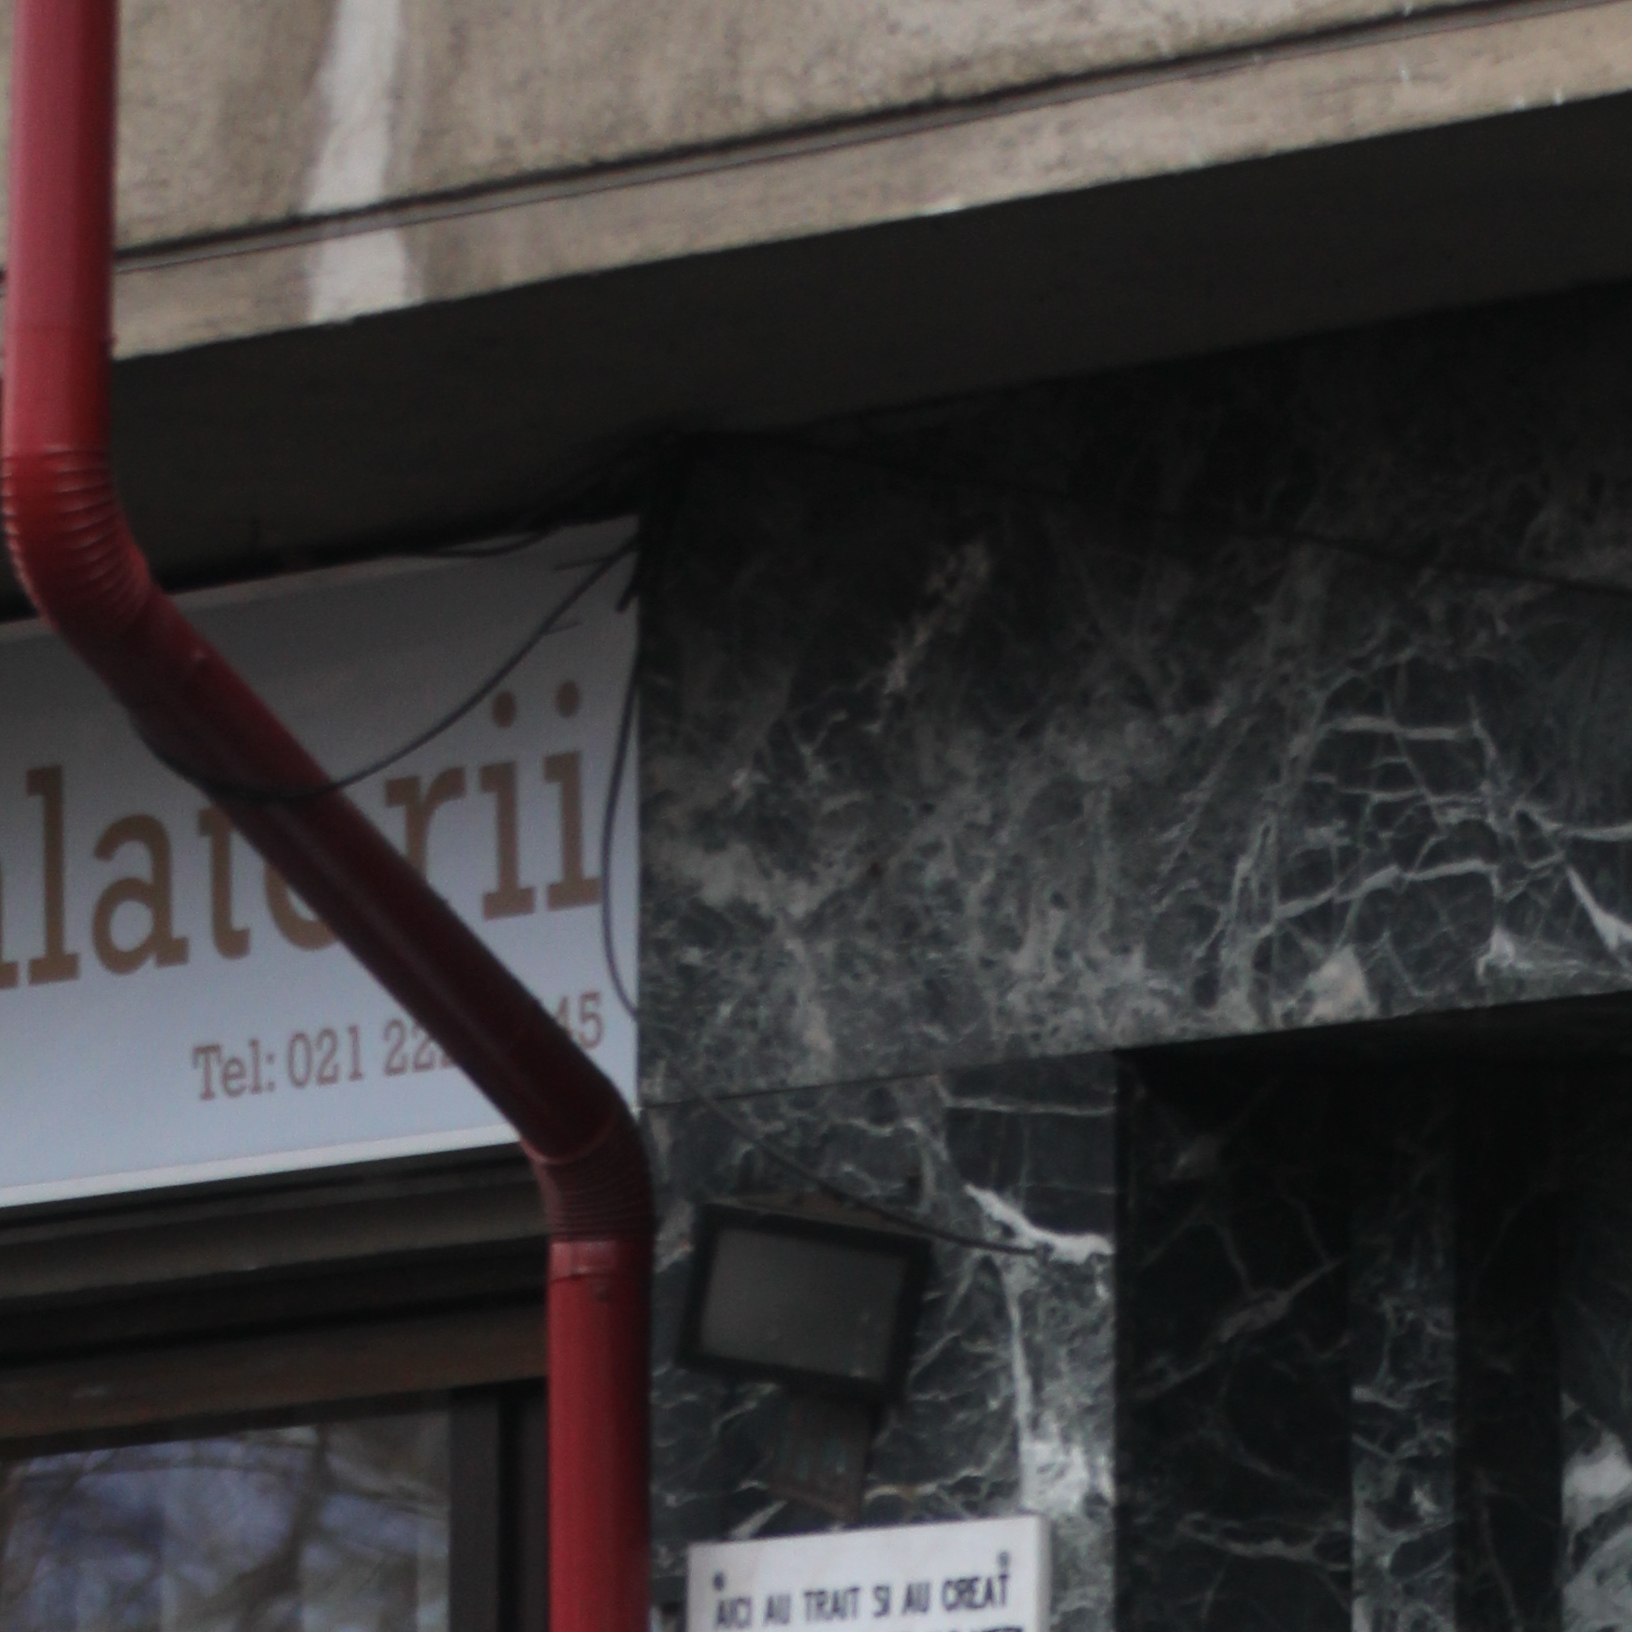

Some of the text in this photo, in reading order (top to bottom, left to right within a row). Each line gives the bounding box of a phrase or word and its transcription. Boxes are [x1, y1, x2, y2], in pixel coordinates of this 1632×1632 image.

[0, 680, 603, 989] latrii
[193, 1034, 276, 1101] Tel:
[287, 1023, 364, 1091] 021
[383, 1017, 456, 1078] 22
[764, 1592, 792, 1626] AU
[804, 1586, 860, 1622] TRAIT
[902, 1579, 930, 1616] AU
[941, 1574, 1010, 1611] CREAT
